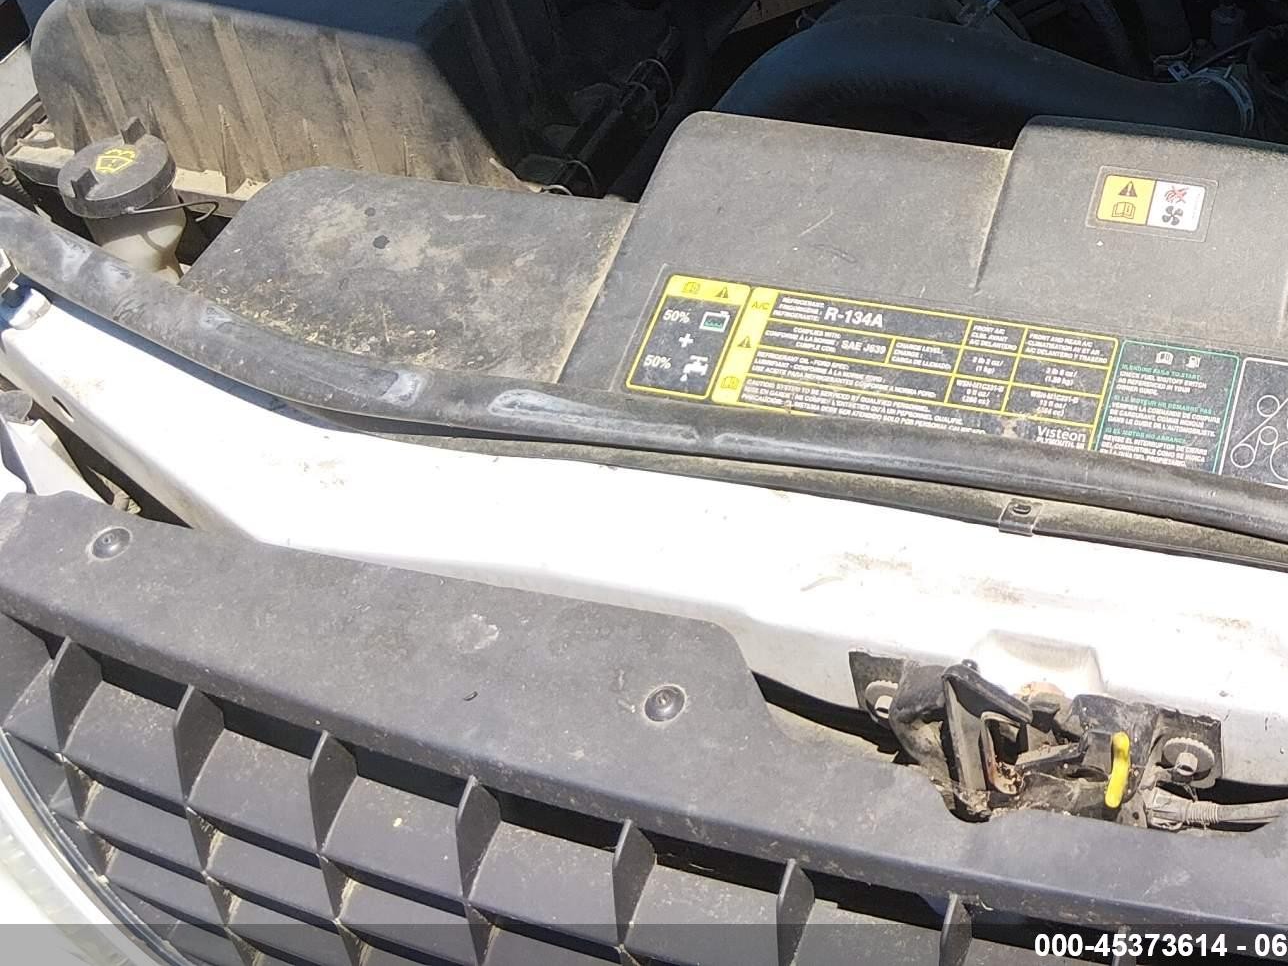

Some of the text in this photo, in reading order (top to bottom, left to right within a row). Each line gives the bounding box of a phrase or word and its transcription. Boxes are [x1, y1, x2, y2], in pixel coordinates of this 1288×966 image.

[662, 309, 690, 323] 50%
[823, 306, 885, 327] R-134A
[840, 340, 886, 354] SAE J639
[643, 354, 672, 369] 50%
[1035, 424, 1087, 442] Visteon
